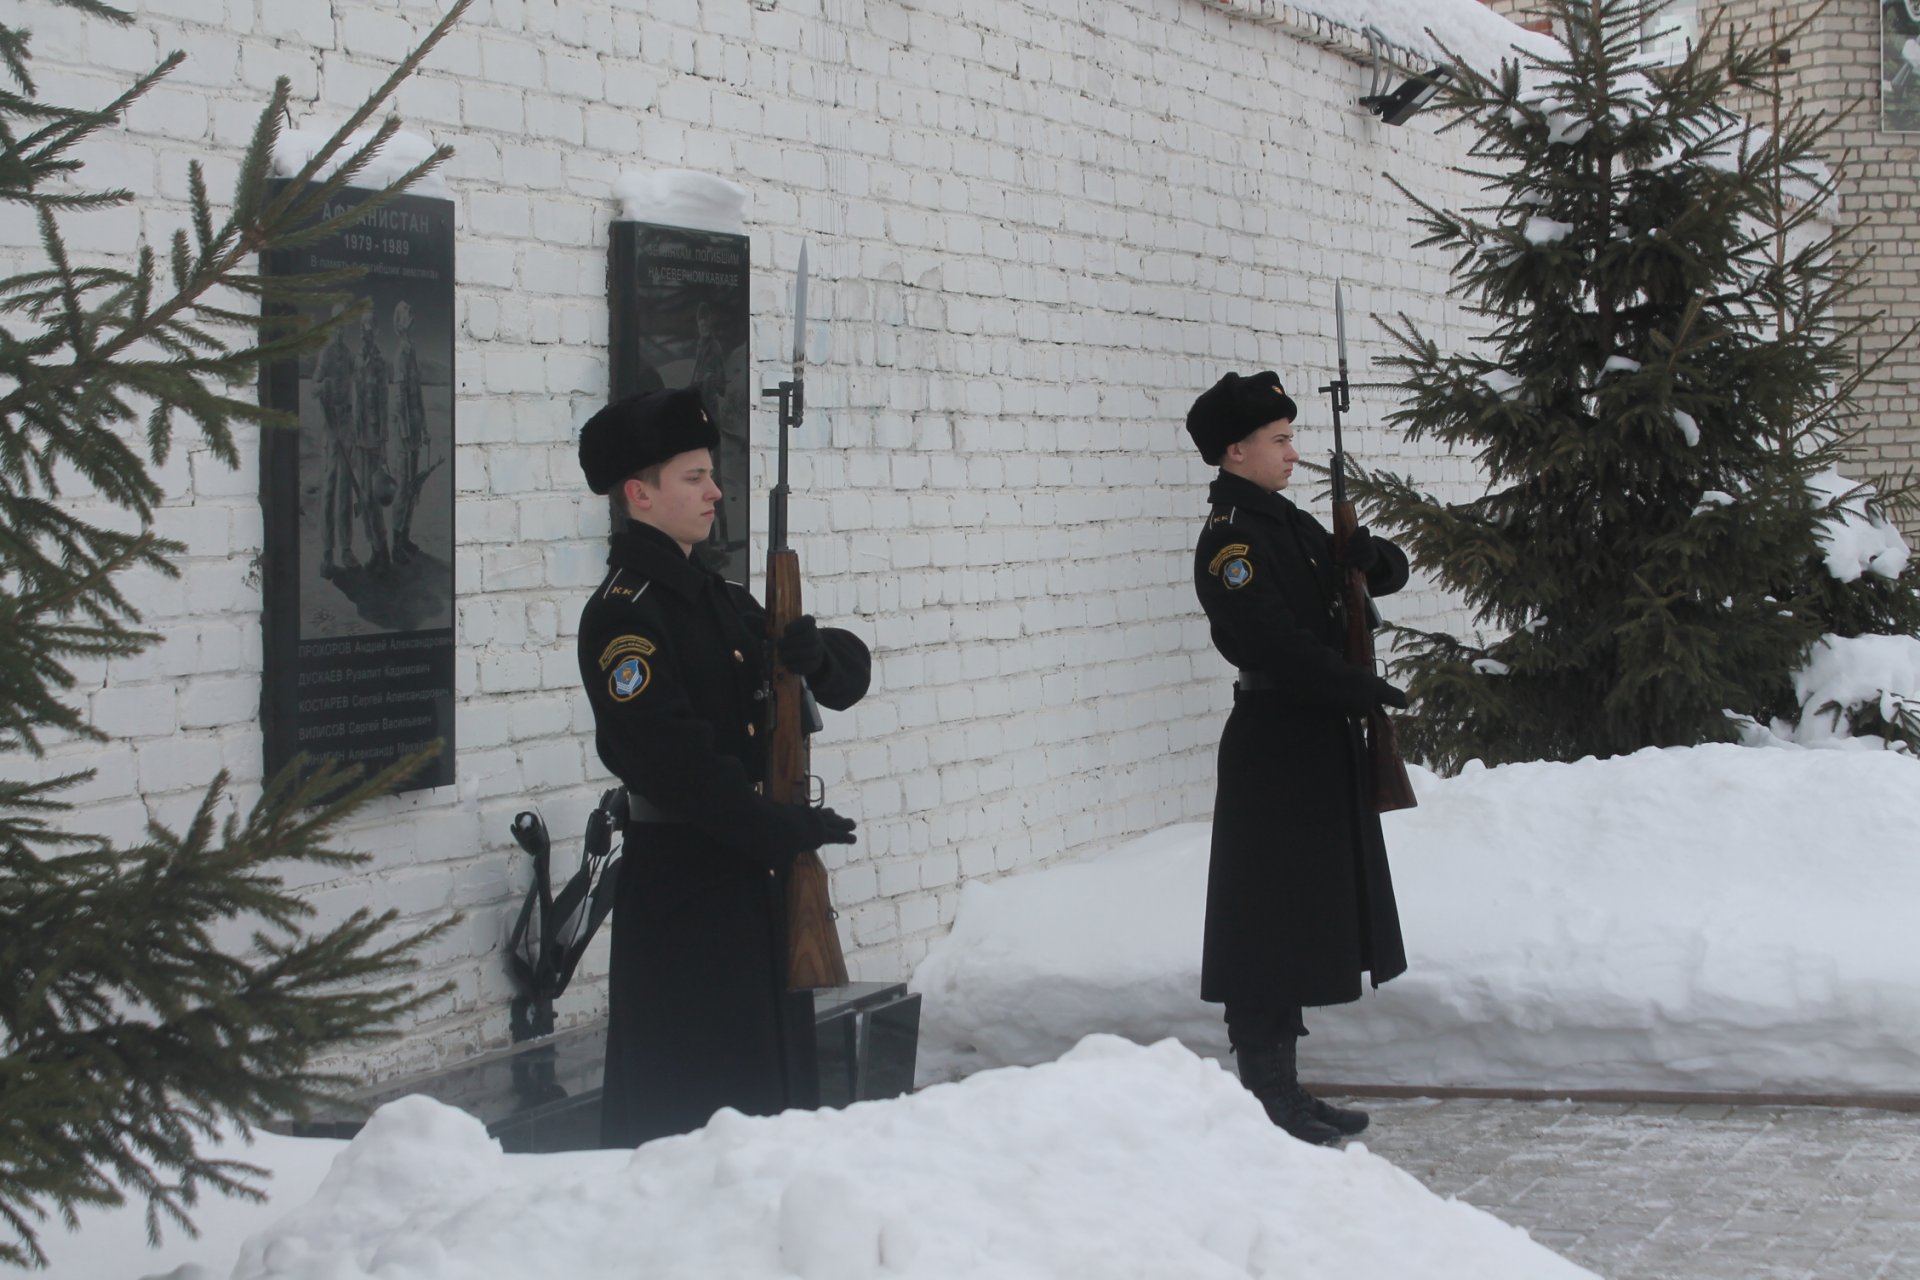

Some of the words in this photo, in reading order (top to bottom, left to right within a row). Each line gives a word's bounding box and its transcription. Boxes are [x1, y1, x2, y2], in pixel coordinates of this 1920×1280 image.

[344, 234, 373, 251] 1979
[382, 238, 410, 256] 1989
[298, 642, 351, 657] ПРОХОРОВ
[354, 640, 387, 655] Андрей
[298, 669, 342, 686] ДУСКАЕВ
[299, 696, 348, 712] КОСТАРЕВ
[352, 692, 383, 709] Сергей
[298, 723, 345, 740] ВИЛИСОВ
[349, 719, 379, 736] Сергей
